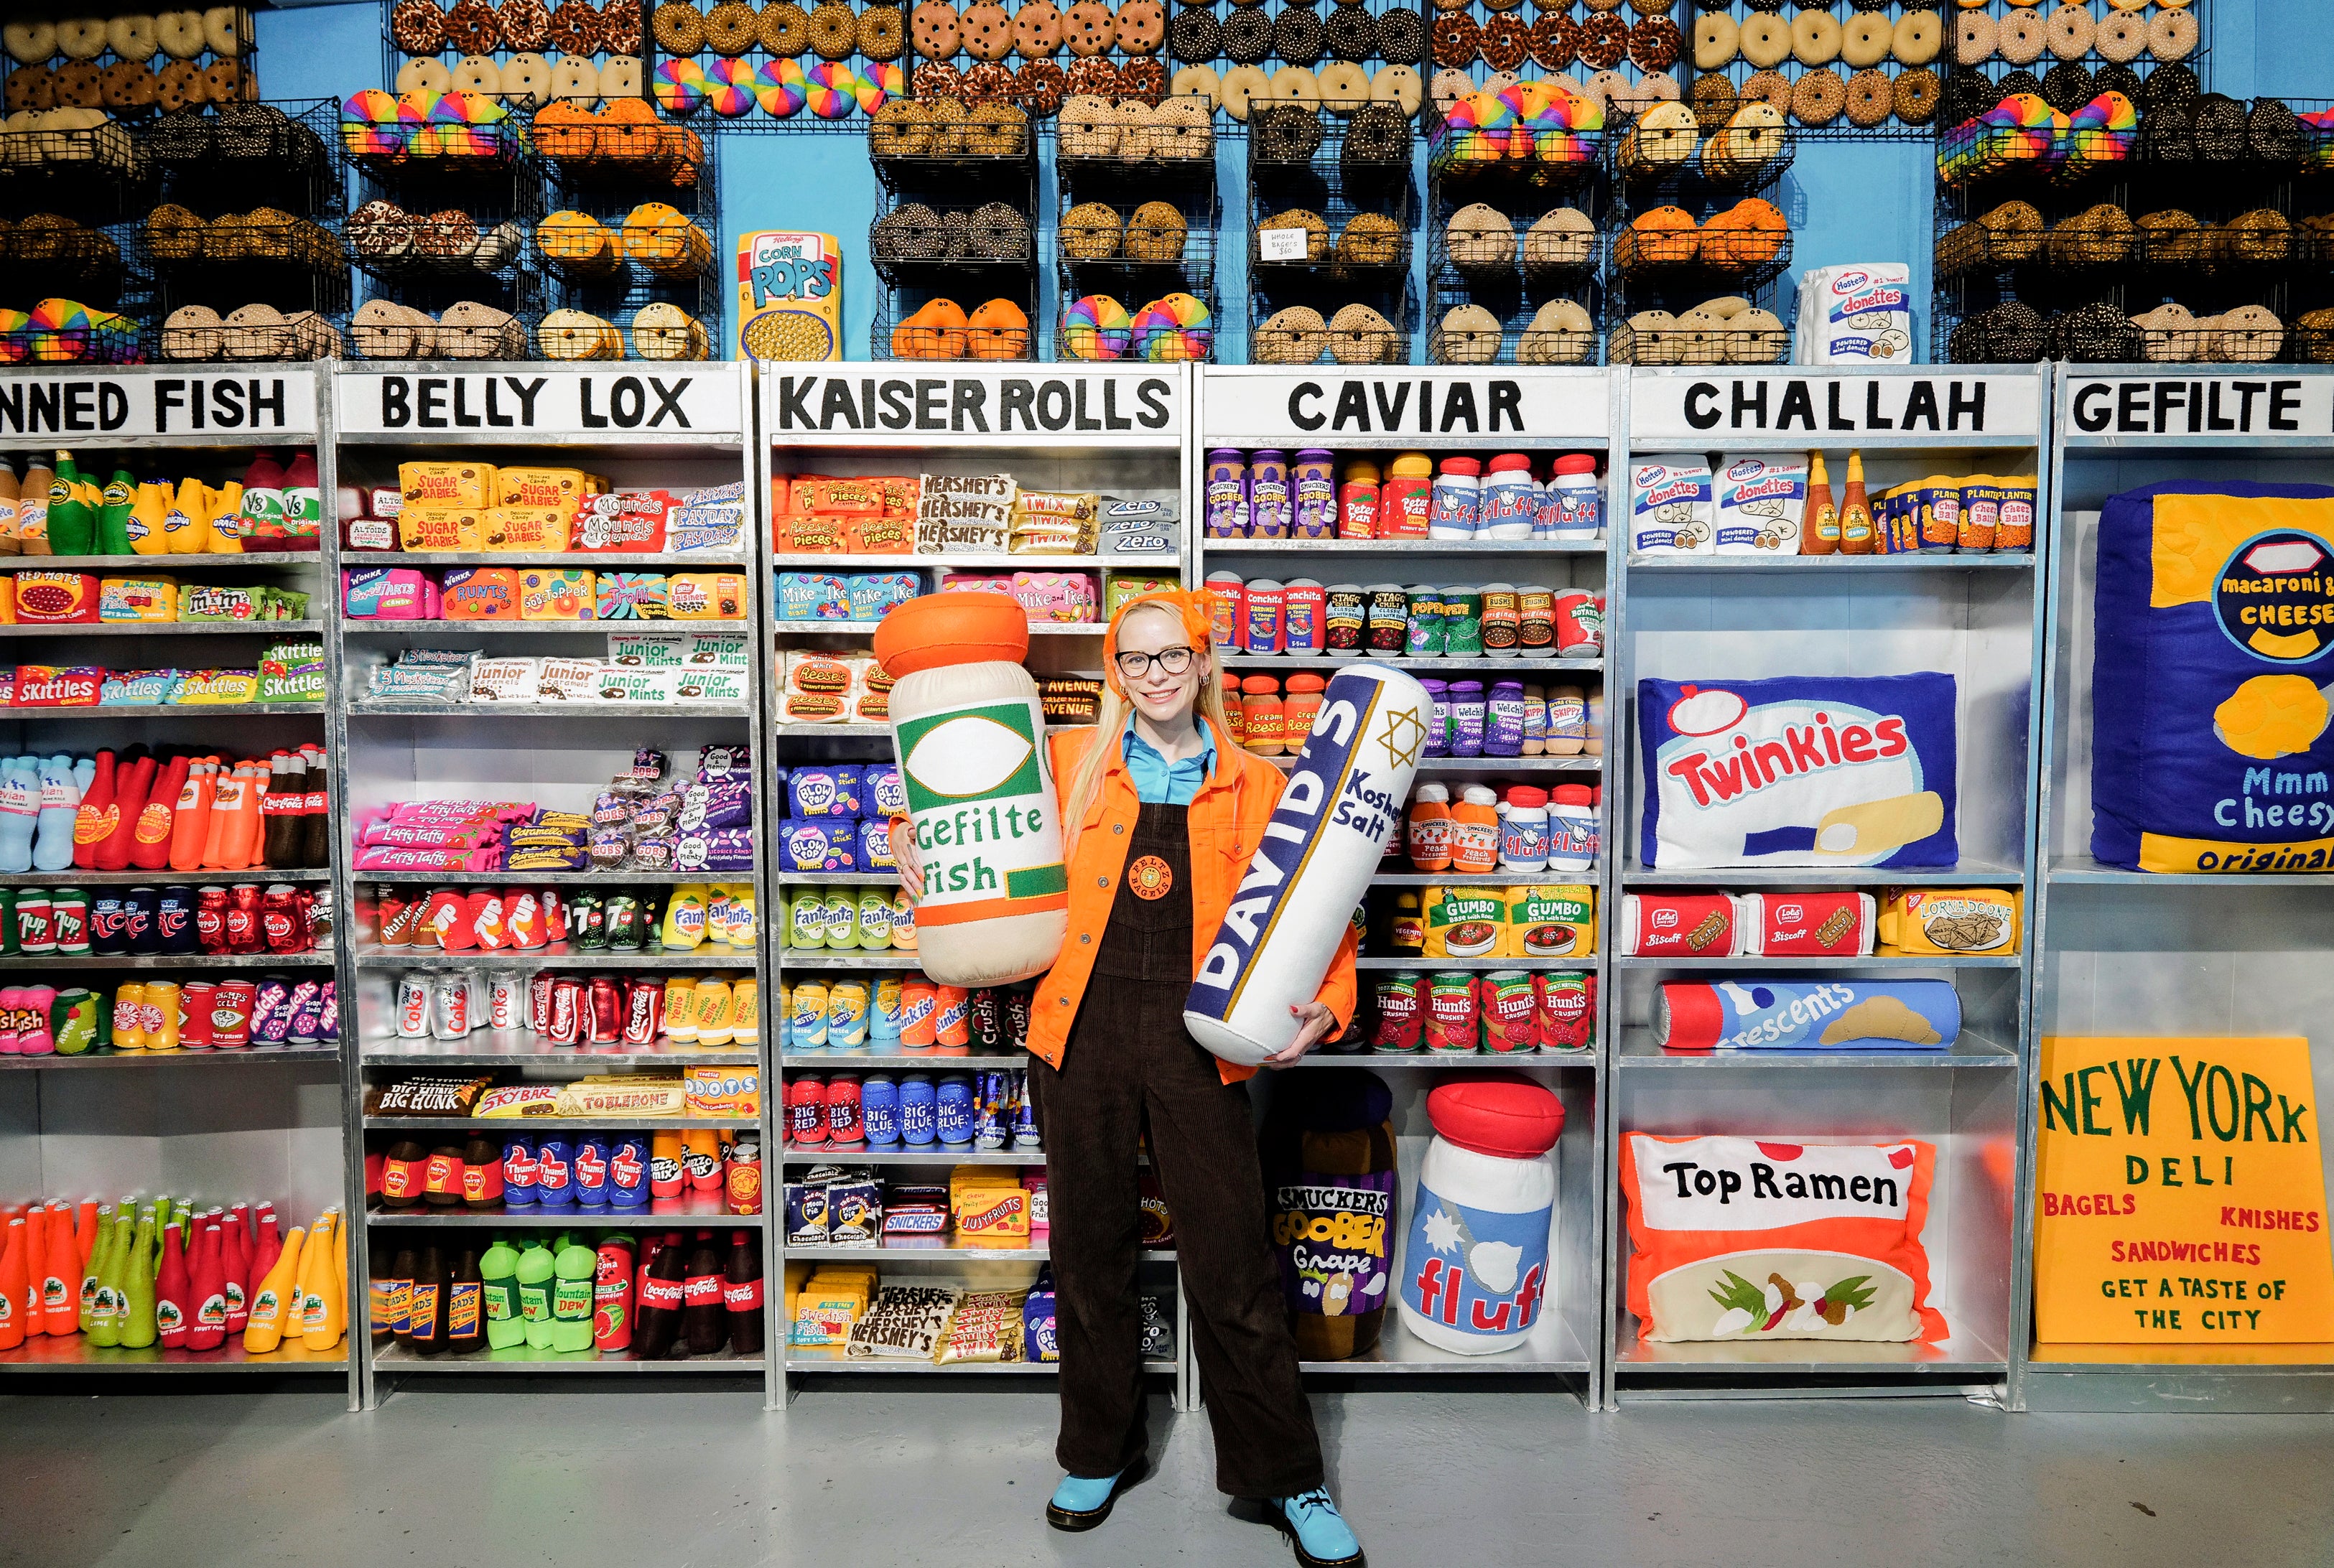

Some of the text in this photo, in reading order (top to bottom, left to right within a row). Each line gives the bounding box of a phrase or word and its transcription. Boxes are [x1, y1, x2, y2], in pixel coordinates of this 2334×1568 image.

[759, 246, 801, 262] CORN
[750, 258, 832, 310] POPS
[1837, 276, 1865, 290] Hostess
[1844, 289, 1900, 312] donettes
[1836, 338, 1867, 347] POWDERED
[155, 379, 285, 433] FISH
[382, 376, 692, 428] BELLY LOX
[780, 376, 1171, 431] KAISER ROLLS
[1288, 381, 1525, 432] CAVIAR
[1684, 381, 1986, 431] CHALLAH
[2074, 381, 2301, 432] GEFILTE
[418, 476, 457, 487] SUGAR
[521, 483, 559, 495] SUGAR
[925, 476, 1007, 495] HERSHEY'S
[422, 488, 458, 500] BABIES
[1209, 493, 1243, 503] GOOBER
[1649, 482, 1698, 504] donettes
[1736, 480, 1793, 501] donettes
[245, 491, 263, 512] V8
[523, 495, 560, 506] BABIES
[599, 498, 662, 513] Mounds
[1347, 503, 1375, 515] Peter
[677, 510, 737, 526] PAYDAY
[1349, 513, 1371, 524] Pan
[2002, 513, 2029, 523] Balls
[353, 526, 387, 534] ALTOIDS
[589, 519, 654, 534] Mounds
[675, 530, 737, 549] PAYDAY
[794, 536, 832, 547] pieces
[919, 524, 1004, 546] HERSHEY'S
[350, 569, 381, 585] WONKA
[2222, 571, 2320, 594] macaroni
[103, 585, 162, 597] Swedish
[457, 585, 507, 601] RUNTS
[610, 588, 649, 605] Trolli
[671, 593, 707, 603] Raisinets
[1248, 594, 1282, 604] Conchita
[1332, 594, 1361, 603] STAGG
[101, 598, 129, 610] Fish
[1018, 593, 1051, 607] Mike
[2241, 603, 2334, 626] CHEESE
[616, 643, 668, 656] Junior
[693, 639, 743, 653] Junior
[646, 656, 682, 666] Mints
[381, 671, 448, 685] 3 Musketeers
[1049, 681, 1100, 692] AVENUE
[629, 689, 665, 701] Mints
[1459, 707, 1484, 717] Welch's
[1553, 707, 1581, 719] SKIPPY
[1668, 712, 1907, 806] Twinkies
[2243, 767, 2328, 795] Mmm
[800, 785, 832, 798] BLOW
[809, 795, 826, 806] POP
[595, 808, 625, 821] GOBS
[1333, 801, 1385, 844] Salt
[2214, 797, 2334, 834] Cheesy
[510, 828, 563, 838] Caramello
[916, 805, 1042, 851] Gefilte
[383, 829, 445, 844] Laffy Taffy
[1196, 699, 1357, 990] DAVID'S
[791, 840, 826, 854] BLOW
[1133, 858, 1170, 878] FELTZ
[1132, 877, 1168, 897] BAGELS
[1446, 900, 1495, 916] GUMBO
[1528, 902, 1581, 916] GUMBO
[1920, 901, 2012, 922] LORNA DOONE
[1449, 914, 1464, 923] Base
[1657, 913, 1675, 921] Lotus
[159, 913, 186, 938] RC
[1396, 928, 1422, 936] VEGEMITE
[1646, 934, 1682, 946] Biscoff
[403, 989, 424, 1032] Coke
[448, 989, 466, 1033] Coke
[671, 996, 683, 1019] Yello
[1377, 996, 1416, 1010] Hunt's
[1432, 998, 1471, 1013] Hunt's
[794, 1012, 817, 1026] NESTEA
[982, 999, 992, 1045] Crush
[694, 1076, 757, 1098] DOTS
[380, 1093, 459, 1110] BIG HUNK
[480, 1088, 551, 1114] SKY BAR
[583, 1093, 669, 1110] TOBLERONE
[2040, 1055, 2307, 1143] NEW YORK
[795, 1106, 814, 1117] BIG
[794, 1117, 817, 1129] RED
[865, 1121, 893, 1132] BLUE
[507, 1164, 537, 1174] Thums
[2126, 1155, 2233, 1187] DELI
[1663, 1162, 1898, 1207] Top Ramen
[1281, 1187, 1388, 1214] SMUCKERS
[2043, 1193, 2135, 1215] BAGELS
[962, 1196, 1020, 1228] JUJYFRUITS
[2221, 1206, 2320, 1232] KNISHES
[887, 1213, 947, 1230] SNICKERS
[1273, 1211, 1386, 1257] GOOBER
[2111, 1240, 2261, 1266] SANDWICHES
[1293, 1245, 1371, 1280] Grape
[2101, 1277, 2287, 1300] GET A TASTE OF
[452, 1295, 475, 1311] DAD'S
[799, 1308, 852, 1322] Swedish
[2134, 1310, 2261, 1330] THE CITY
[851, 1322, 931, 1350] HERSHEY'S
